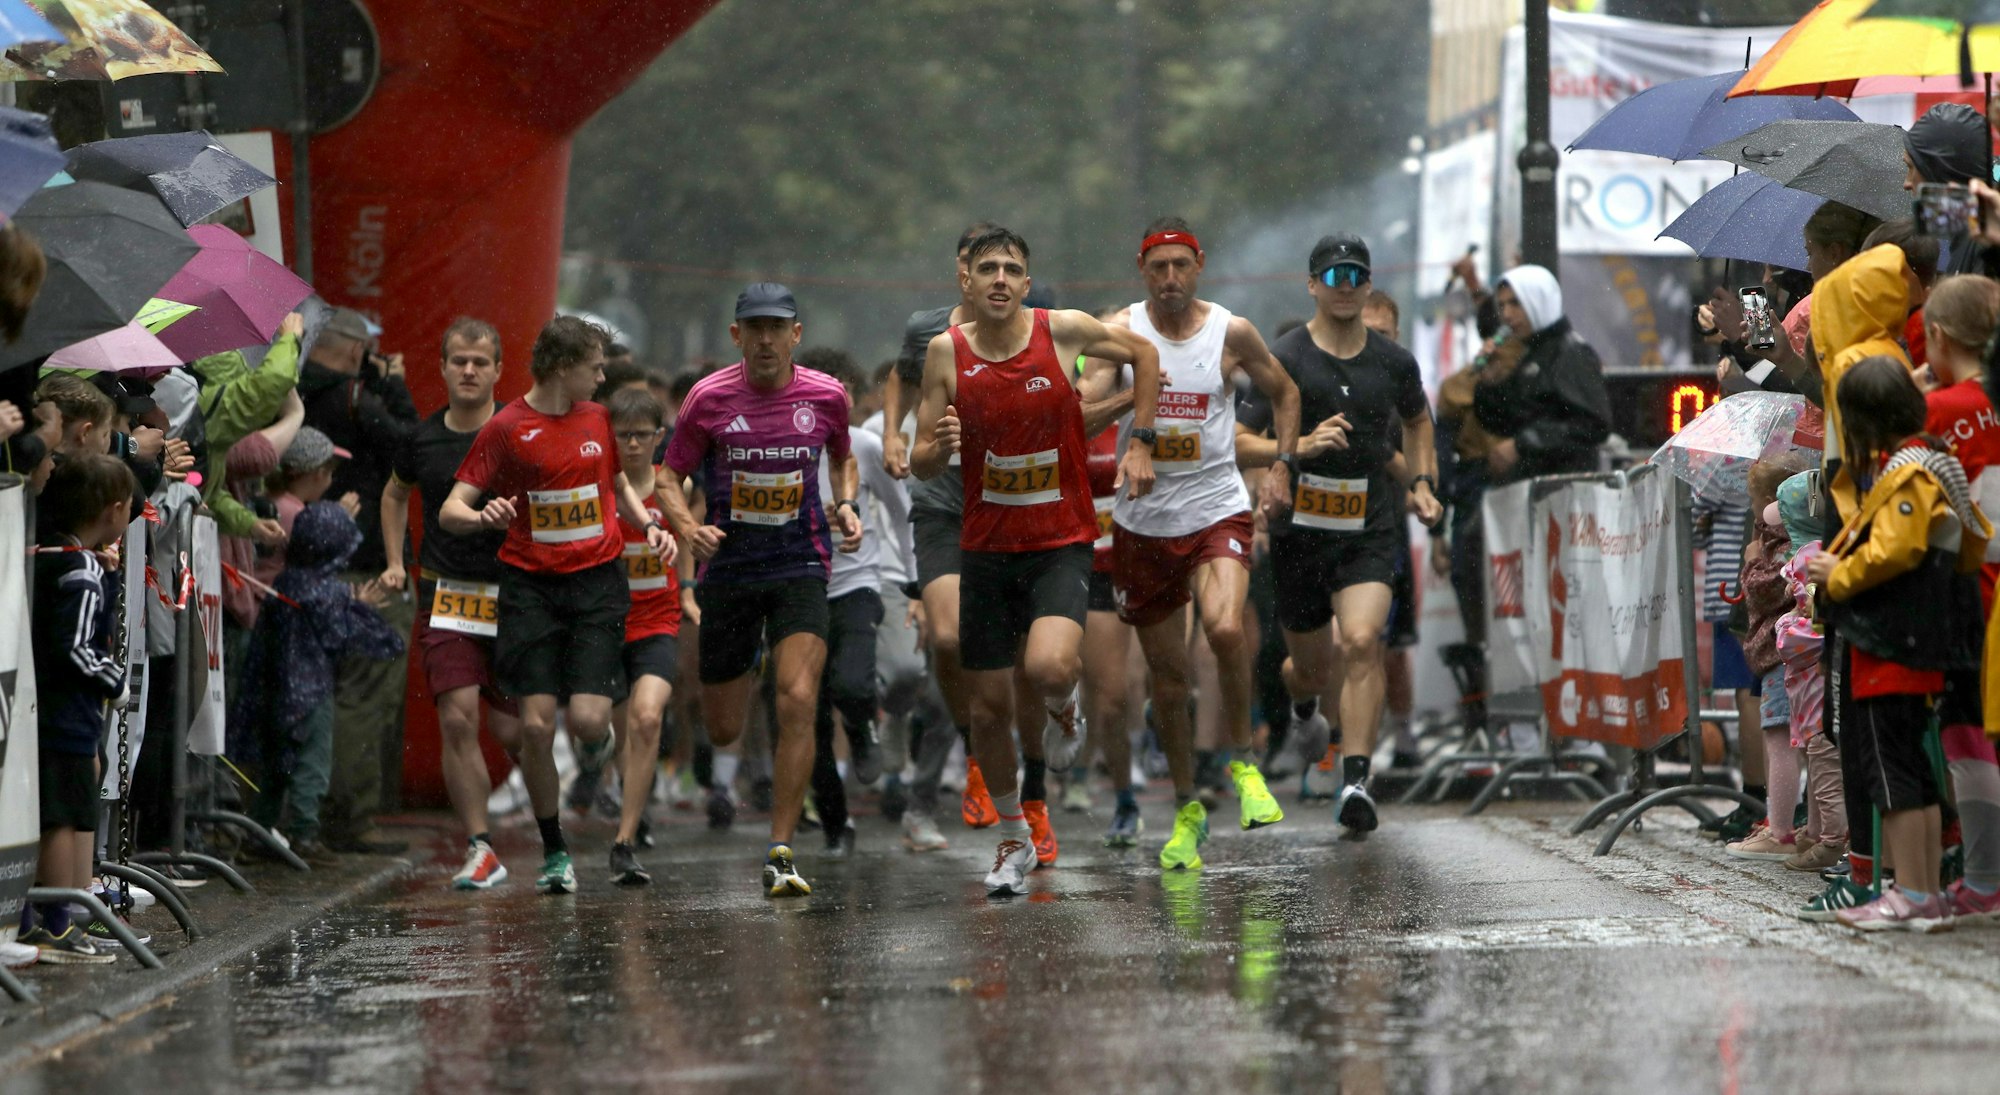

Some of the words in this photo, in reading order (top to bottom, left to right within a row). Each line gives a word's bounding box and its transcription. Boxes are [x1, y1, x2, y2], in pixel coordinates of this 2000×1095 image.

[347, 205, 388, 297] Köln
[1155, 405, 1206, 417] OLONIA
[987, 465, 1054, 492] 5217
[737, 486, 799, 511] 5054
[1300, 489, 1362, 516] 5130
[536, 501, 597, 528] 5144
[757, 514, 779, 524] John
[438, 594, 498, 621] 5113
